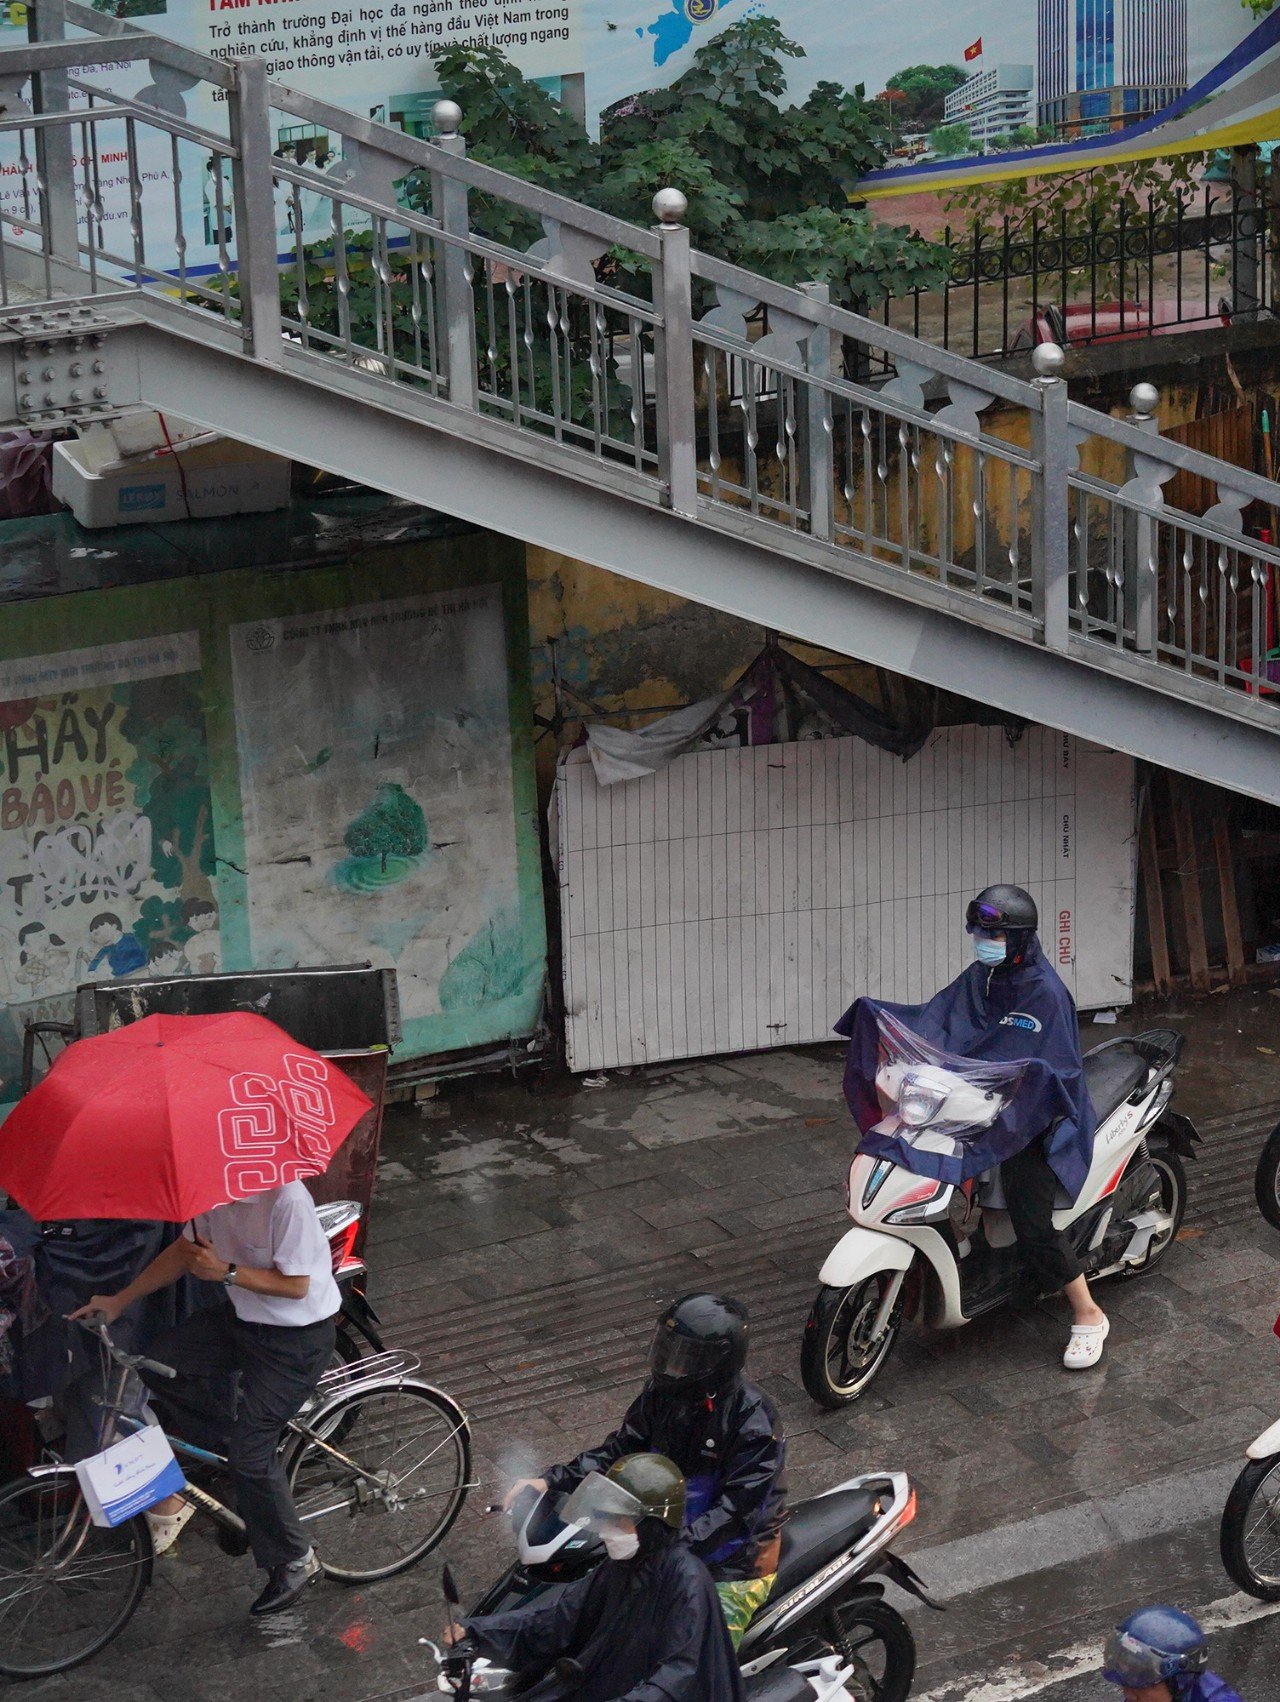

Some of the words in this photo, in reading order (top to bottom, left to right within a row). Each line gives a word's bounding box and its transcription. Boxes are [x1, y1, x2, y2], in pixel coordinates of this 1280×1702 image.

[209, 21, 231, 38] Trở
[238, 19, 275, 35] thành
[282, 14, 326, 30] trường
[331, 10, 353, 26] Đại
[359, 8, 383, 22] học
[390, 4, 406, 17] đa
[413, 1, 453, 16] ngành
[210, 43, 255, 60] nghiên
[260, 36, 289, 53] cứu,
[293, 31, 333, 48] khẳng
[338, 29, 366, 47] định
[371, 27, 382, 42] vị
[386, 21, 407, 38] thế
[411, 21, 442, 36] hàng
[447, 15, 470, 30] đầu
[475, 14, 498, 29] Việt
[503, 12, 531, 24] Nam
[536, 7, 569, 20] trong
[266, 59, 294, 75] giao
[298, 54, 335, 68] thông
[338, 50, 361, 66] vận
[365, 45, 384, 61] tải,
[387, 45, 403, 58] có
[406, 43, 421, 57] uy
[462, 33, 489, 48] chất
[492, 33, 527, 48] lượng
[531, 27, 569, 41] ngang
[101, 152, 128, 163] MINH
[1059, 910, 1071, 933] GHI
